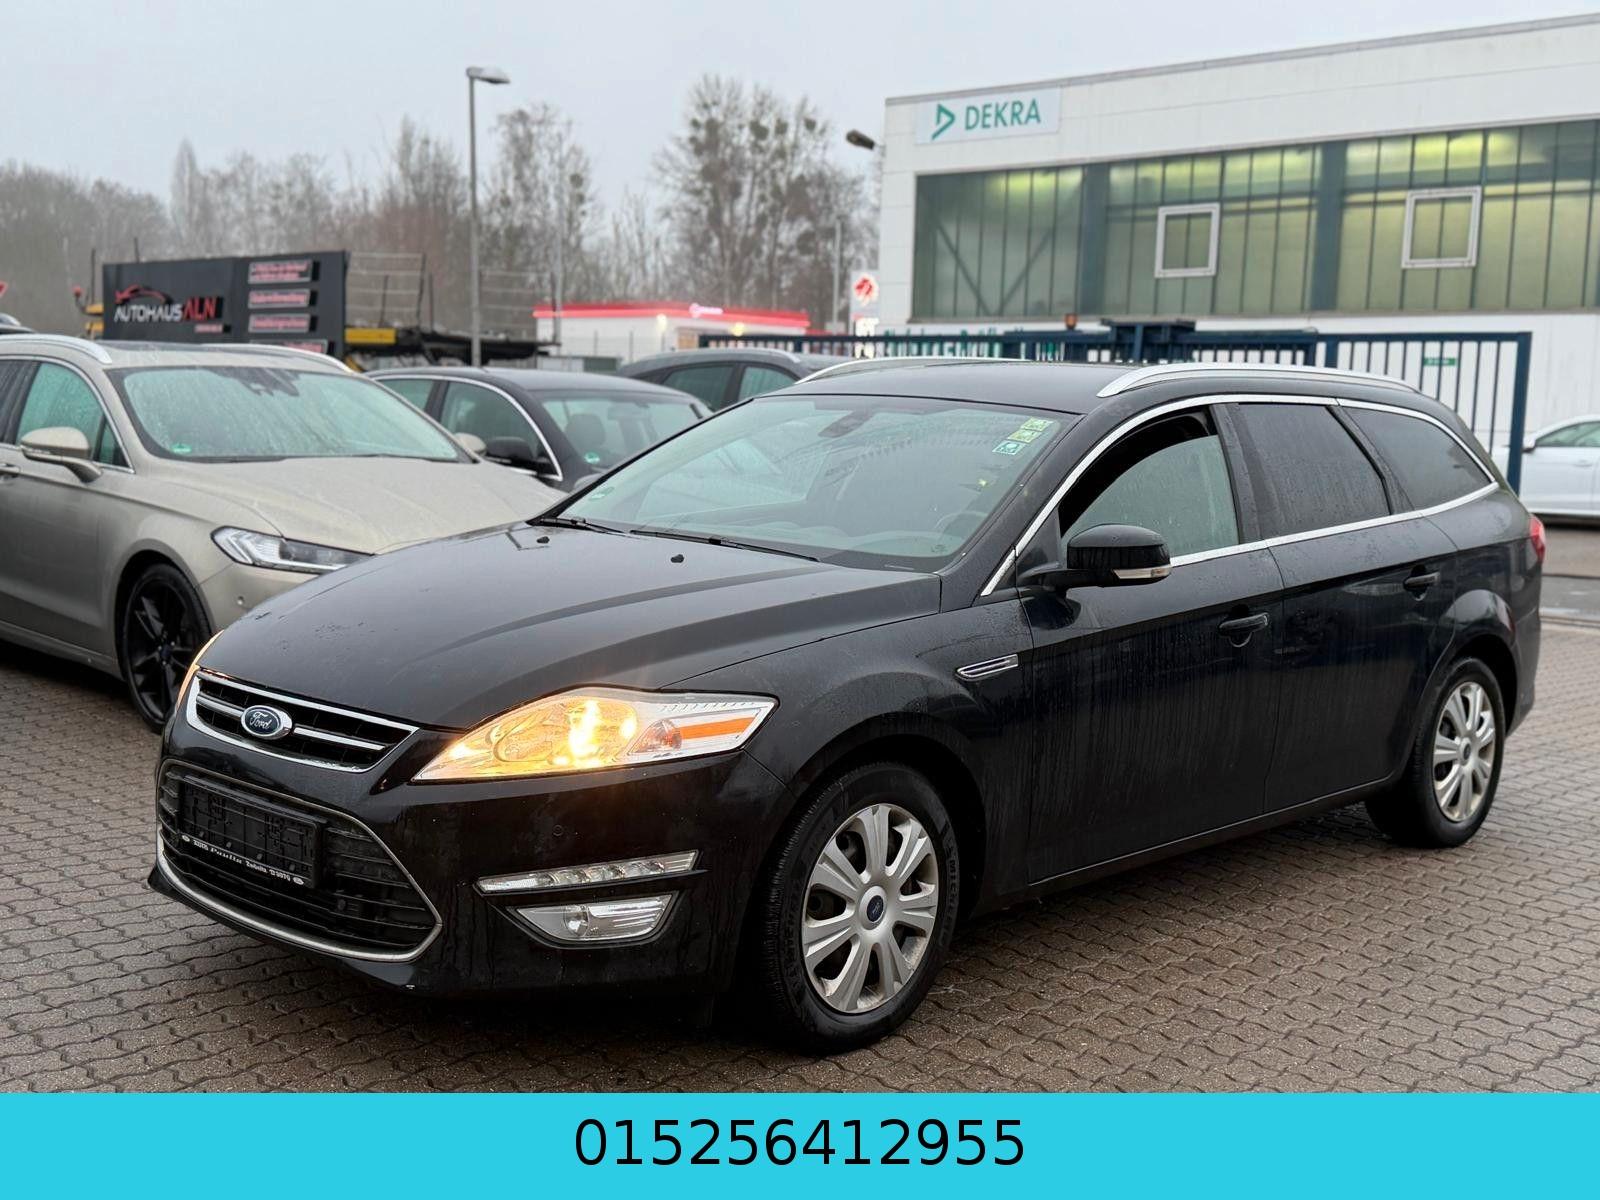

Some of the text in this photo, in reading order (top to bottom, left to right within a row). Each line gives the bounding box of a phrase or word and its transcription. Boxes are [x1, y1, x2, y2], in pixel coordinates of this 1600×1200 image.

[964, 98, 1042, 131] DEKRA
[113, 296, 217, 322] AUTOHAUS ALN
[250, 711, 273, 730] Ford
